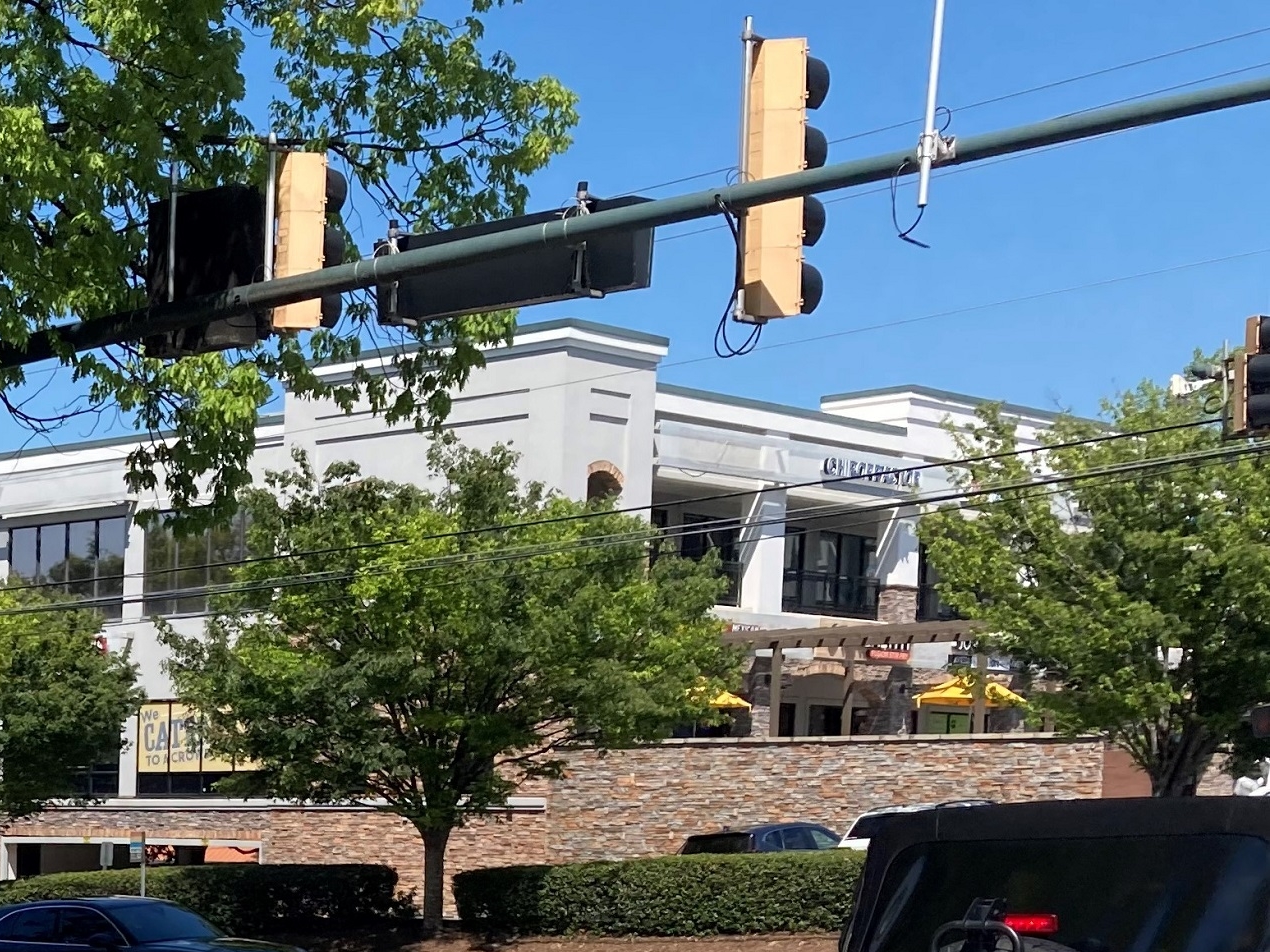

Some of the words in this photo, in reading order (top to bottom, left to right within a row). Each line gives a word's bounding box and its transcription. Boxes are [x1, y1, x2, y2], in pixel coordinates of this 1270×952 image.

[141, 709, 159, 722] We
[144, 719, 186, 752] CAT
[145, 755, 160, 766] TO
